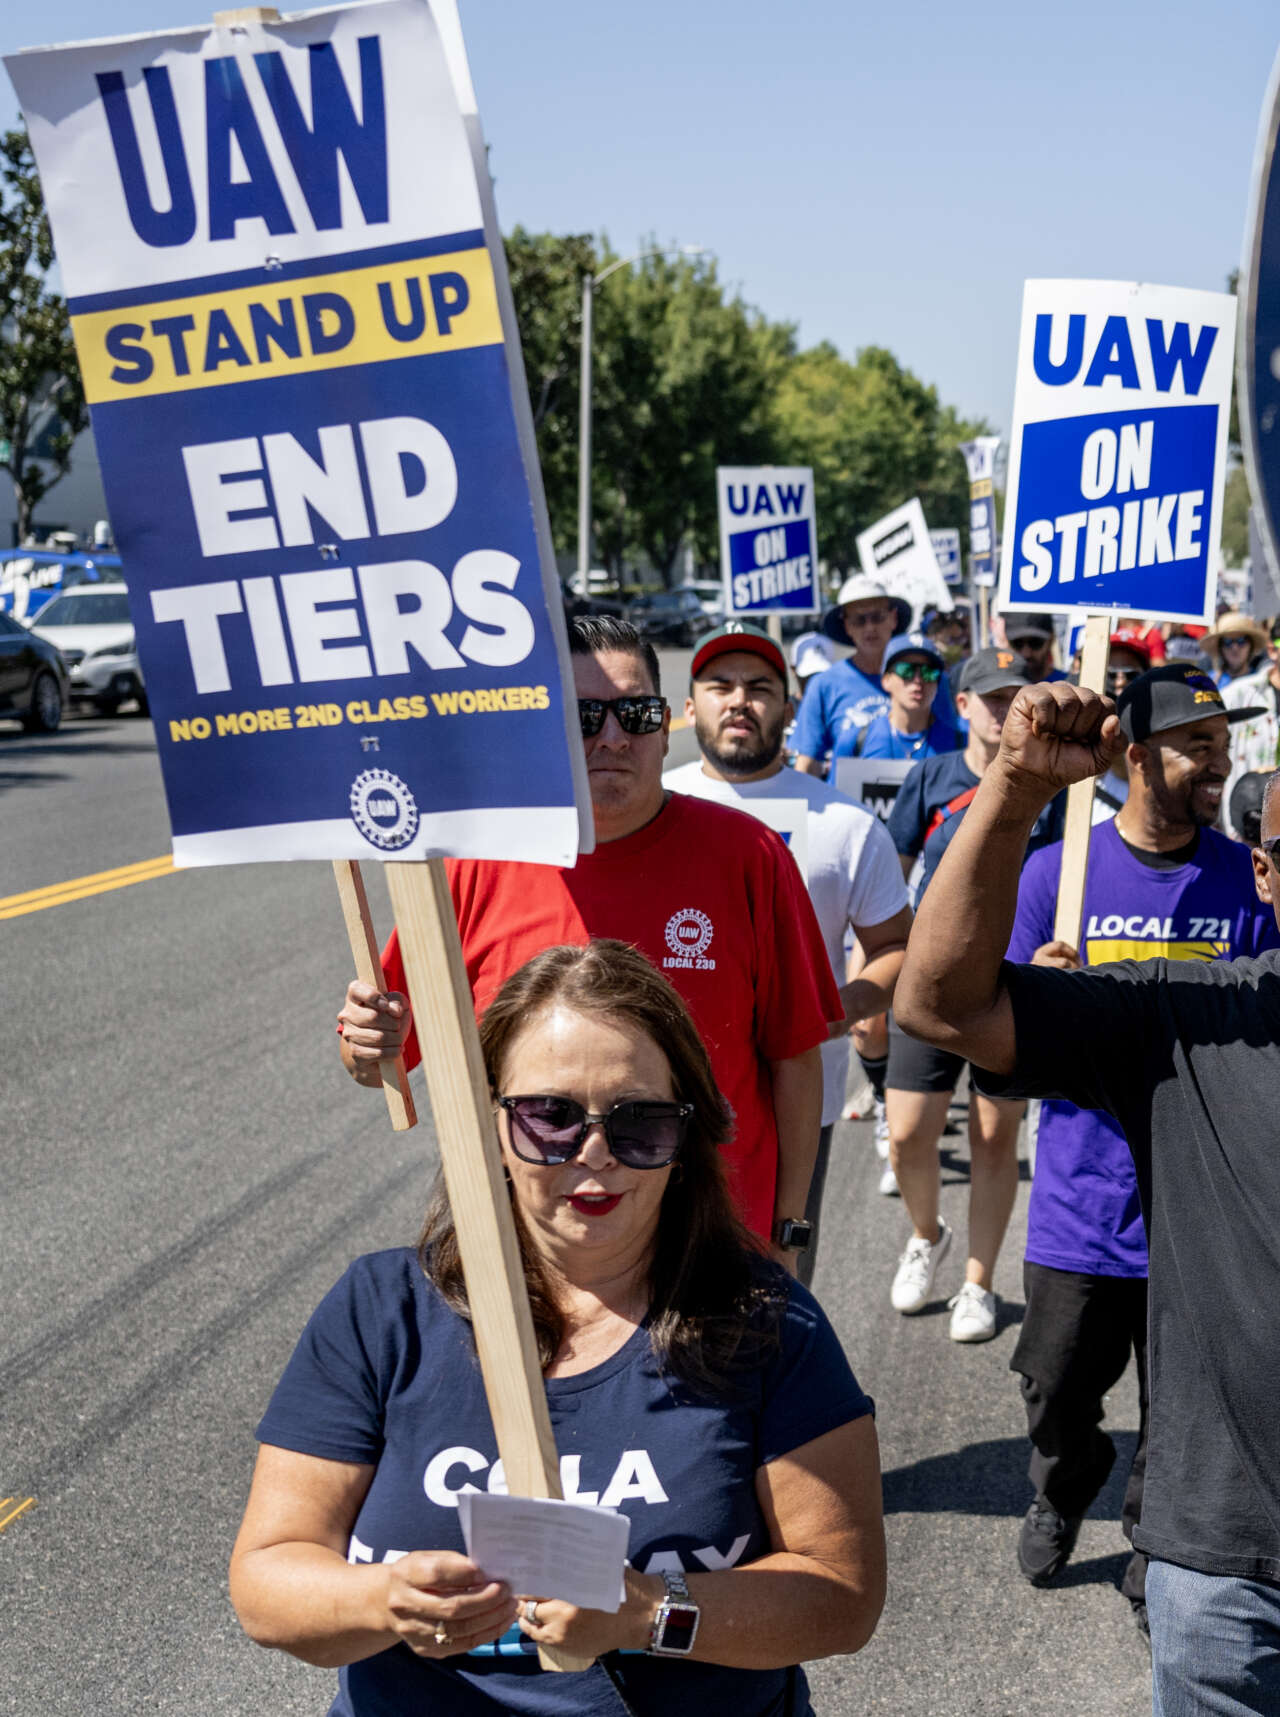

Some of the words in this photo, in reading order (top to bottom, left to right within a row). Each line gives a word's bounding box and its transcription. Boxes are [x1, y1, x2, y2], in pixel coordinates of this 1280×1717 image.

[95, 35, 390, 248] UAW
[104, 292, 357, 385] STAND
[376, 271, 471, 342] UP
[1033, 313, 1220, 396] UAW
[182, 416, 458, 557] END
[1080, 420, 1154, 501] ON
[727, 483, 806, 516] UAW
[753, 525, 787, 567] ON
[1018, 489, 1205, 592] STRIKE
[733, 553, 812, 609] STRIKE
[150, 549, 536, 695] TIERS
[169, 718, 212, 742] NO
[217, 707, 293, 737] MORE
[296, 703, 344, 729] 2ND
[346, 695, 429, 725] CLASS
[430, 685, 551, 716] WORKERS
[679, 926, 700, 939] UAW
[1086, 914, 1178, 939] LOCAL
[1187, 917, 1232, 940] 721
[663, 957, 694, 968] LOCAL
[696, 958, 716, 970] 230
